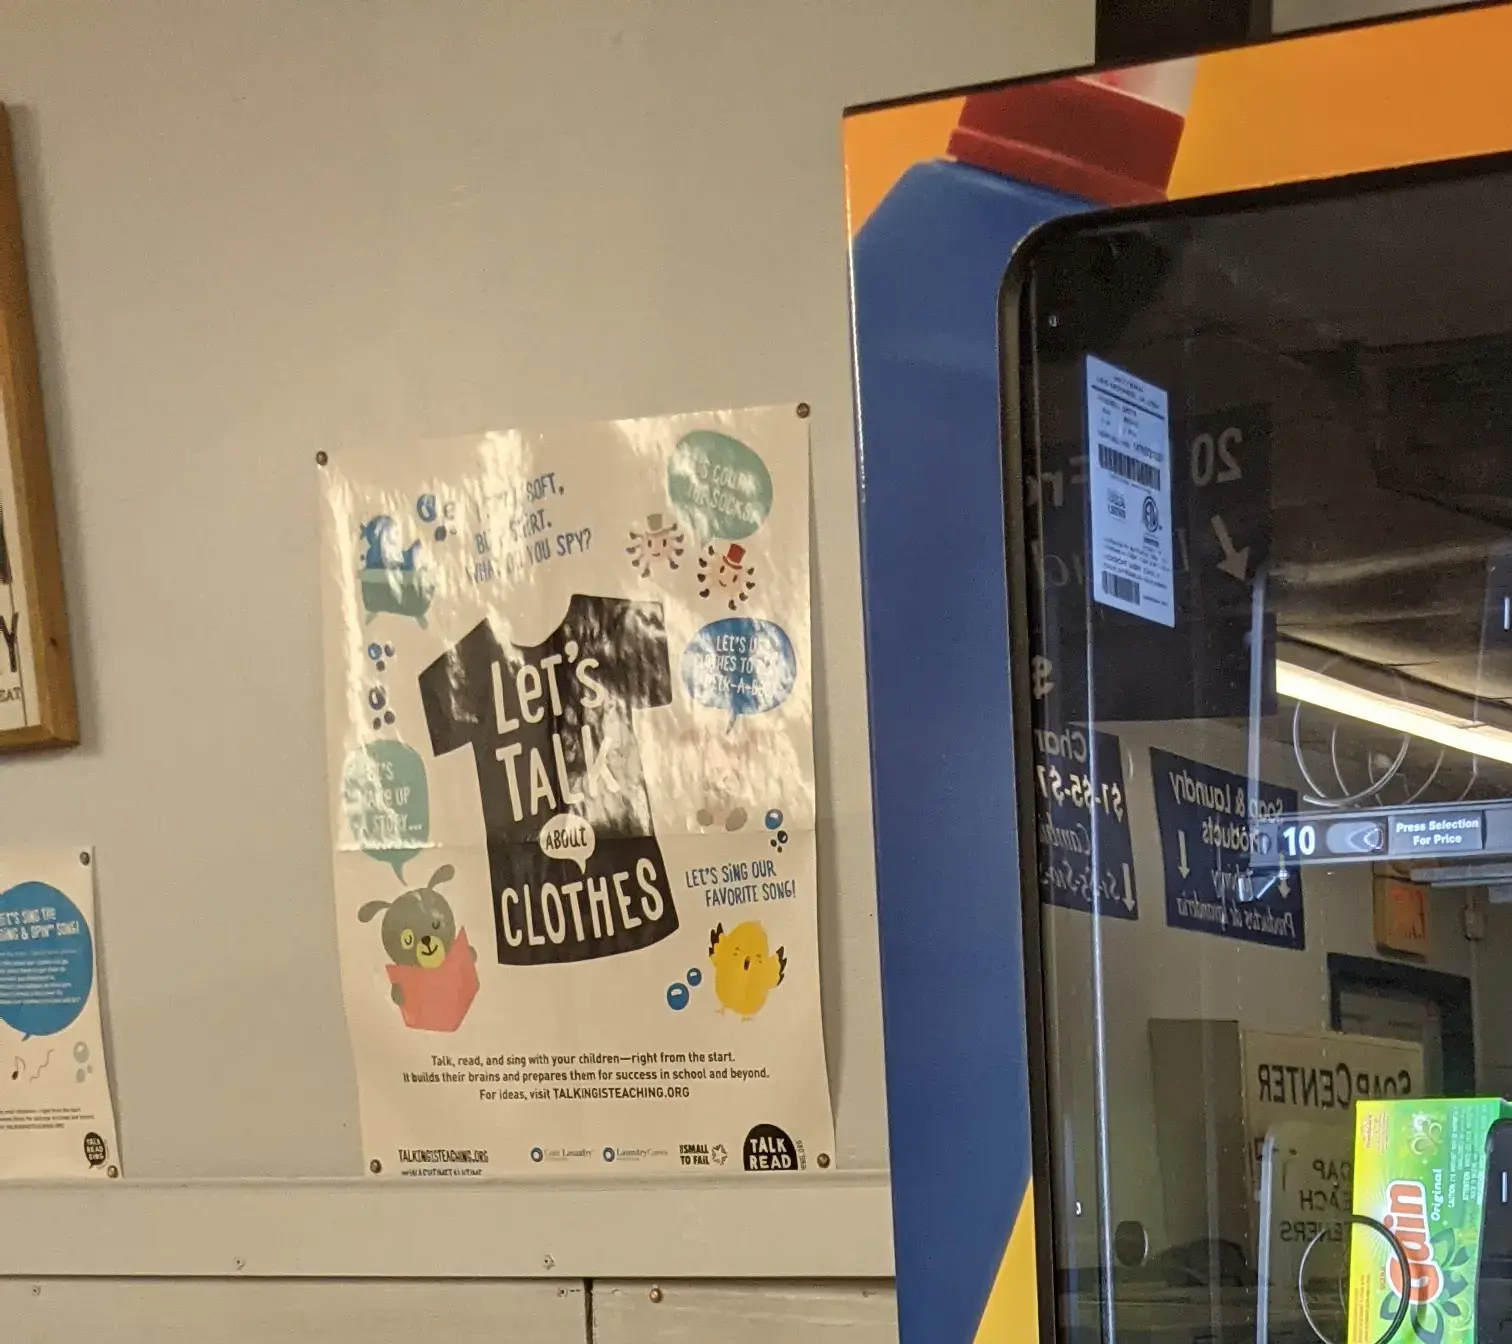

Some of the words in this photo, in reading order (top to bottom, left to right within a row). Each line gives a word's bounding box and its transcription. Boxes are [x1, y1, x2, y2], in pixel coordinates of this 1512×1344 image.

[556, 526, 592, 556] SPY?
[495, 724, 620, 822] TALK
[1283, 825, 1316, 856] 10
[684, 868, 718, 888] LET'S
[752, 860, 776, 877] OUR
[501, 857, 663, 946] CLOTHES
[704, 880, 758, 908] FAVORITE
[762, 876, 796, 900] SONG!
[431, 1054, 456, 1068] Talk,
[458, 1055, 484, 1067] read,
[486, 1054, 504, 1066] and
[506, 1054, 526, 1068] sing
[528, 1053, 550, 1065] with
[551, 1054, 574, 1067] your
[660, 1052, 686, 1063] from
[688, 1052, 706, 1062] the
[708, 1052, 736, 1062] start.
[411, 1071, 440, 1082] builds
[442, 1070, 466, 1082] their
[468, 1070, 500, 1082] brains
[502, 1070, 520, 1082] and
[522, 1071, 568, 1084] prepares
[569, 1069, 596, 1081] them
[598, 1069, 613, 1081] for
[616, 1070, 658, 1080] success
[660, 1069, 670, 1080] in
[672, 1068, 707, 1080] school
[709, 1068, 728, 1080] and
[730, 1068, 770, 1081] beyond.
[499, 1088, 528, 1101] ideas,
[529, 1088, 551, 1100] visit
[552, 1086, 690, 1100] TALKINGISTEACHING.ORG
[750, 1136, 787, 1154] TALK
[750, 1154, 792, 1170] READ
[1431, 1168, 1444, 1221] Original
[1384, 1180, 1444, 1304] Gain
